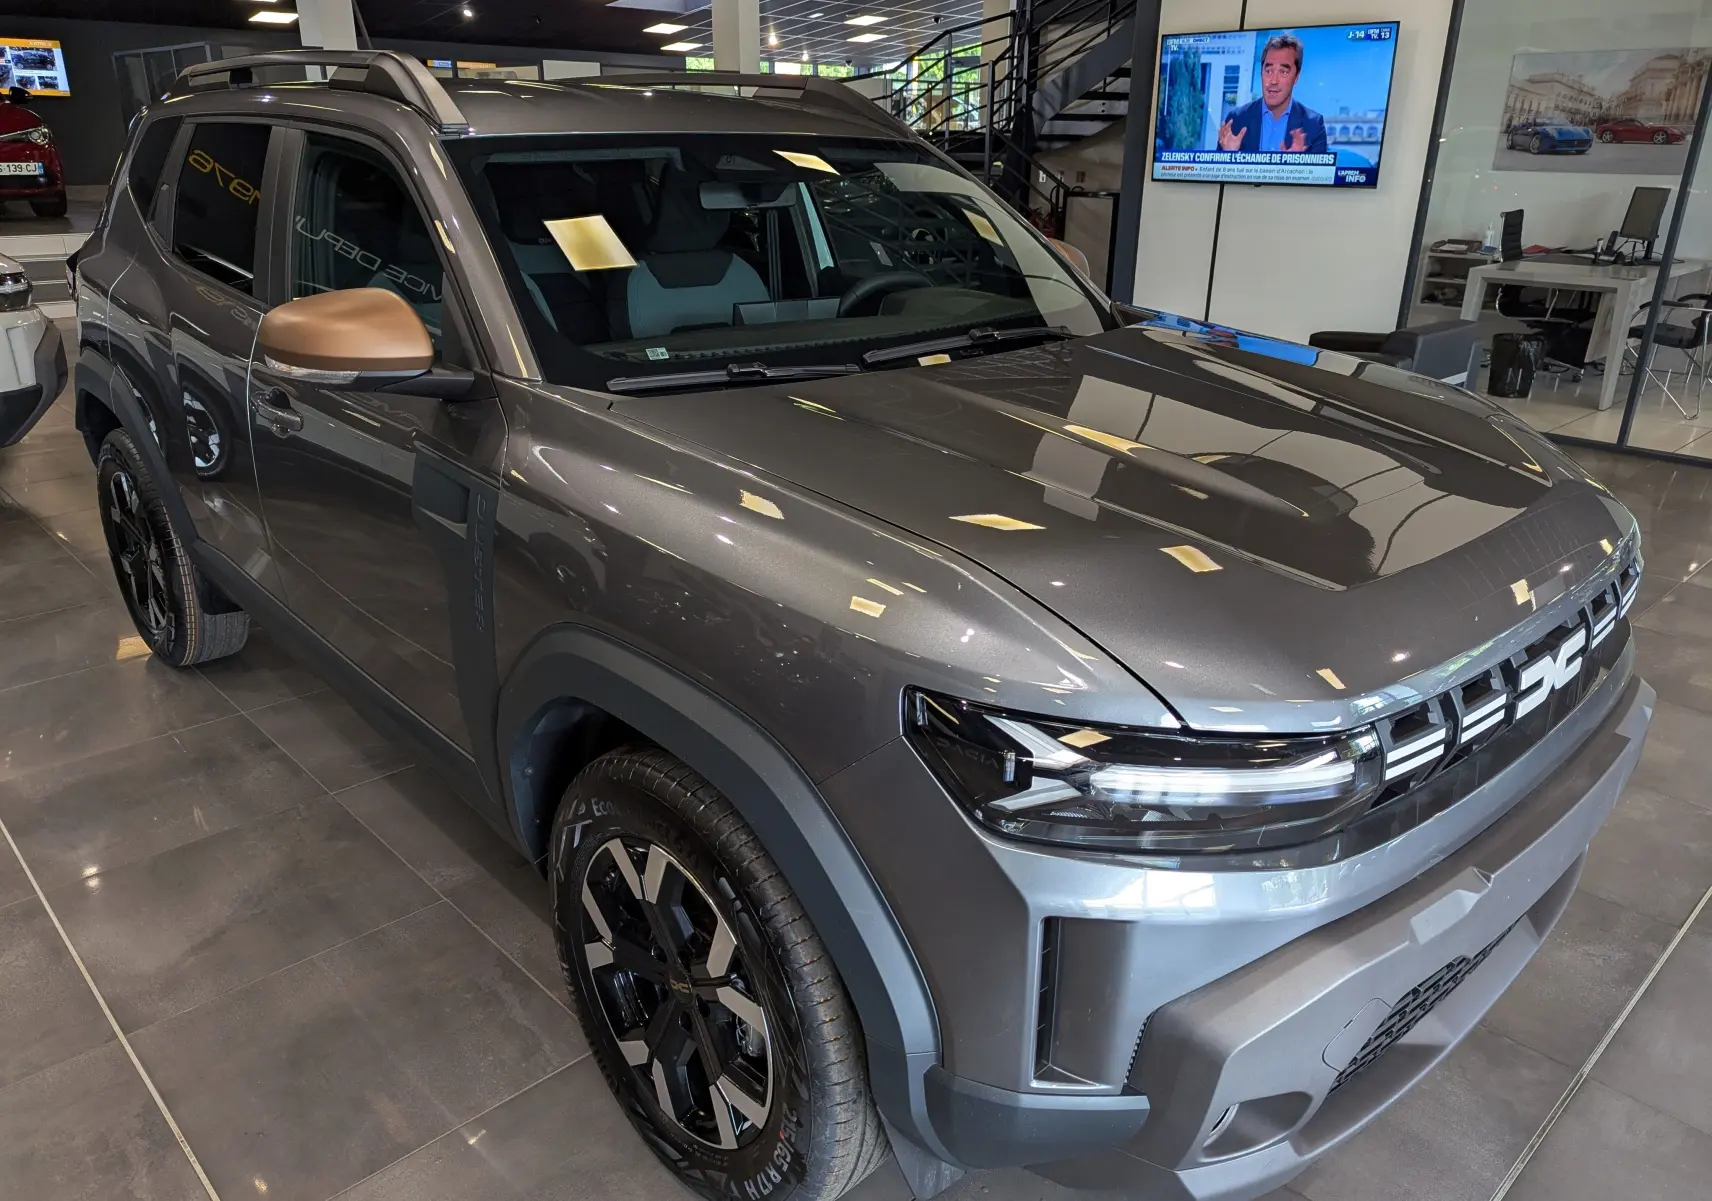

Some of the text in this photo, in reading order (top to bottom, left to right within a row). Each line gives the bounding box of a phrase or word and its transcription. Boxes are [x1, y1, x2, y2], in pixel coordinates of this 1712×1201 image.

[1161, 152, 1334, 165] ZELENSKY CONFIRME L'ÉCHANGE DE PRISONNIERS
[473, 494, 485, 633] DUSTER
